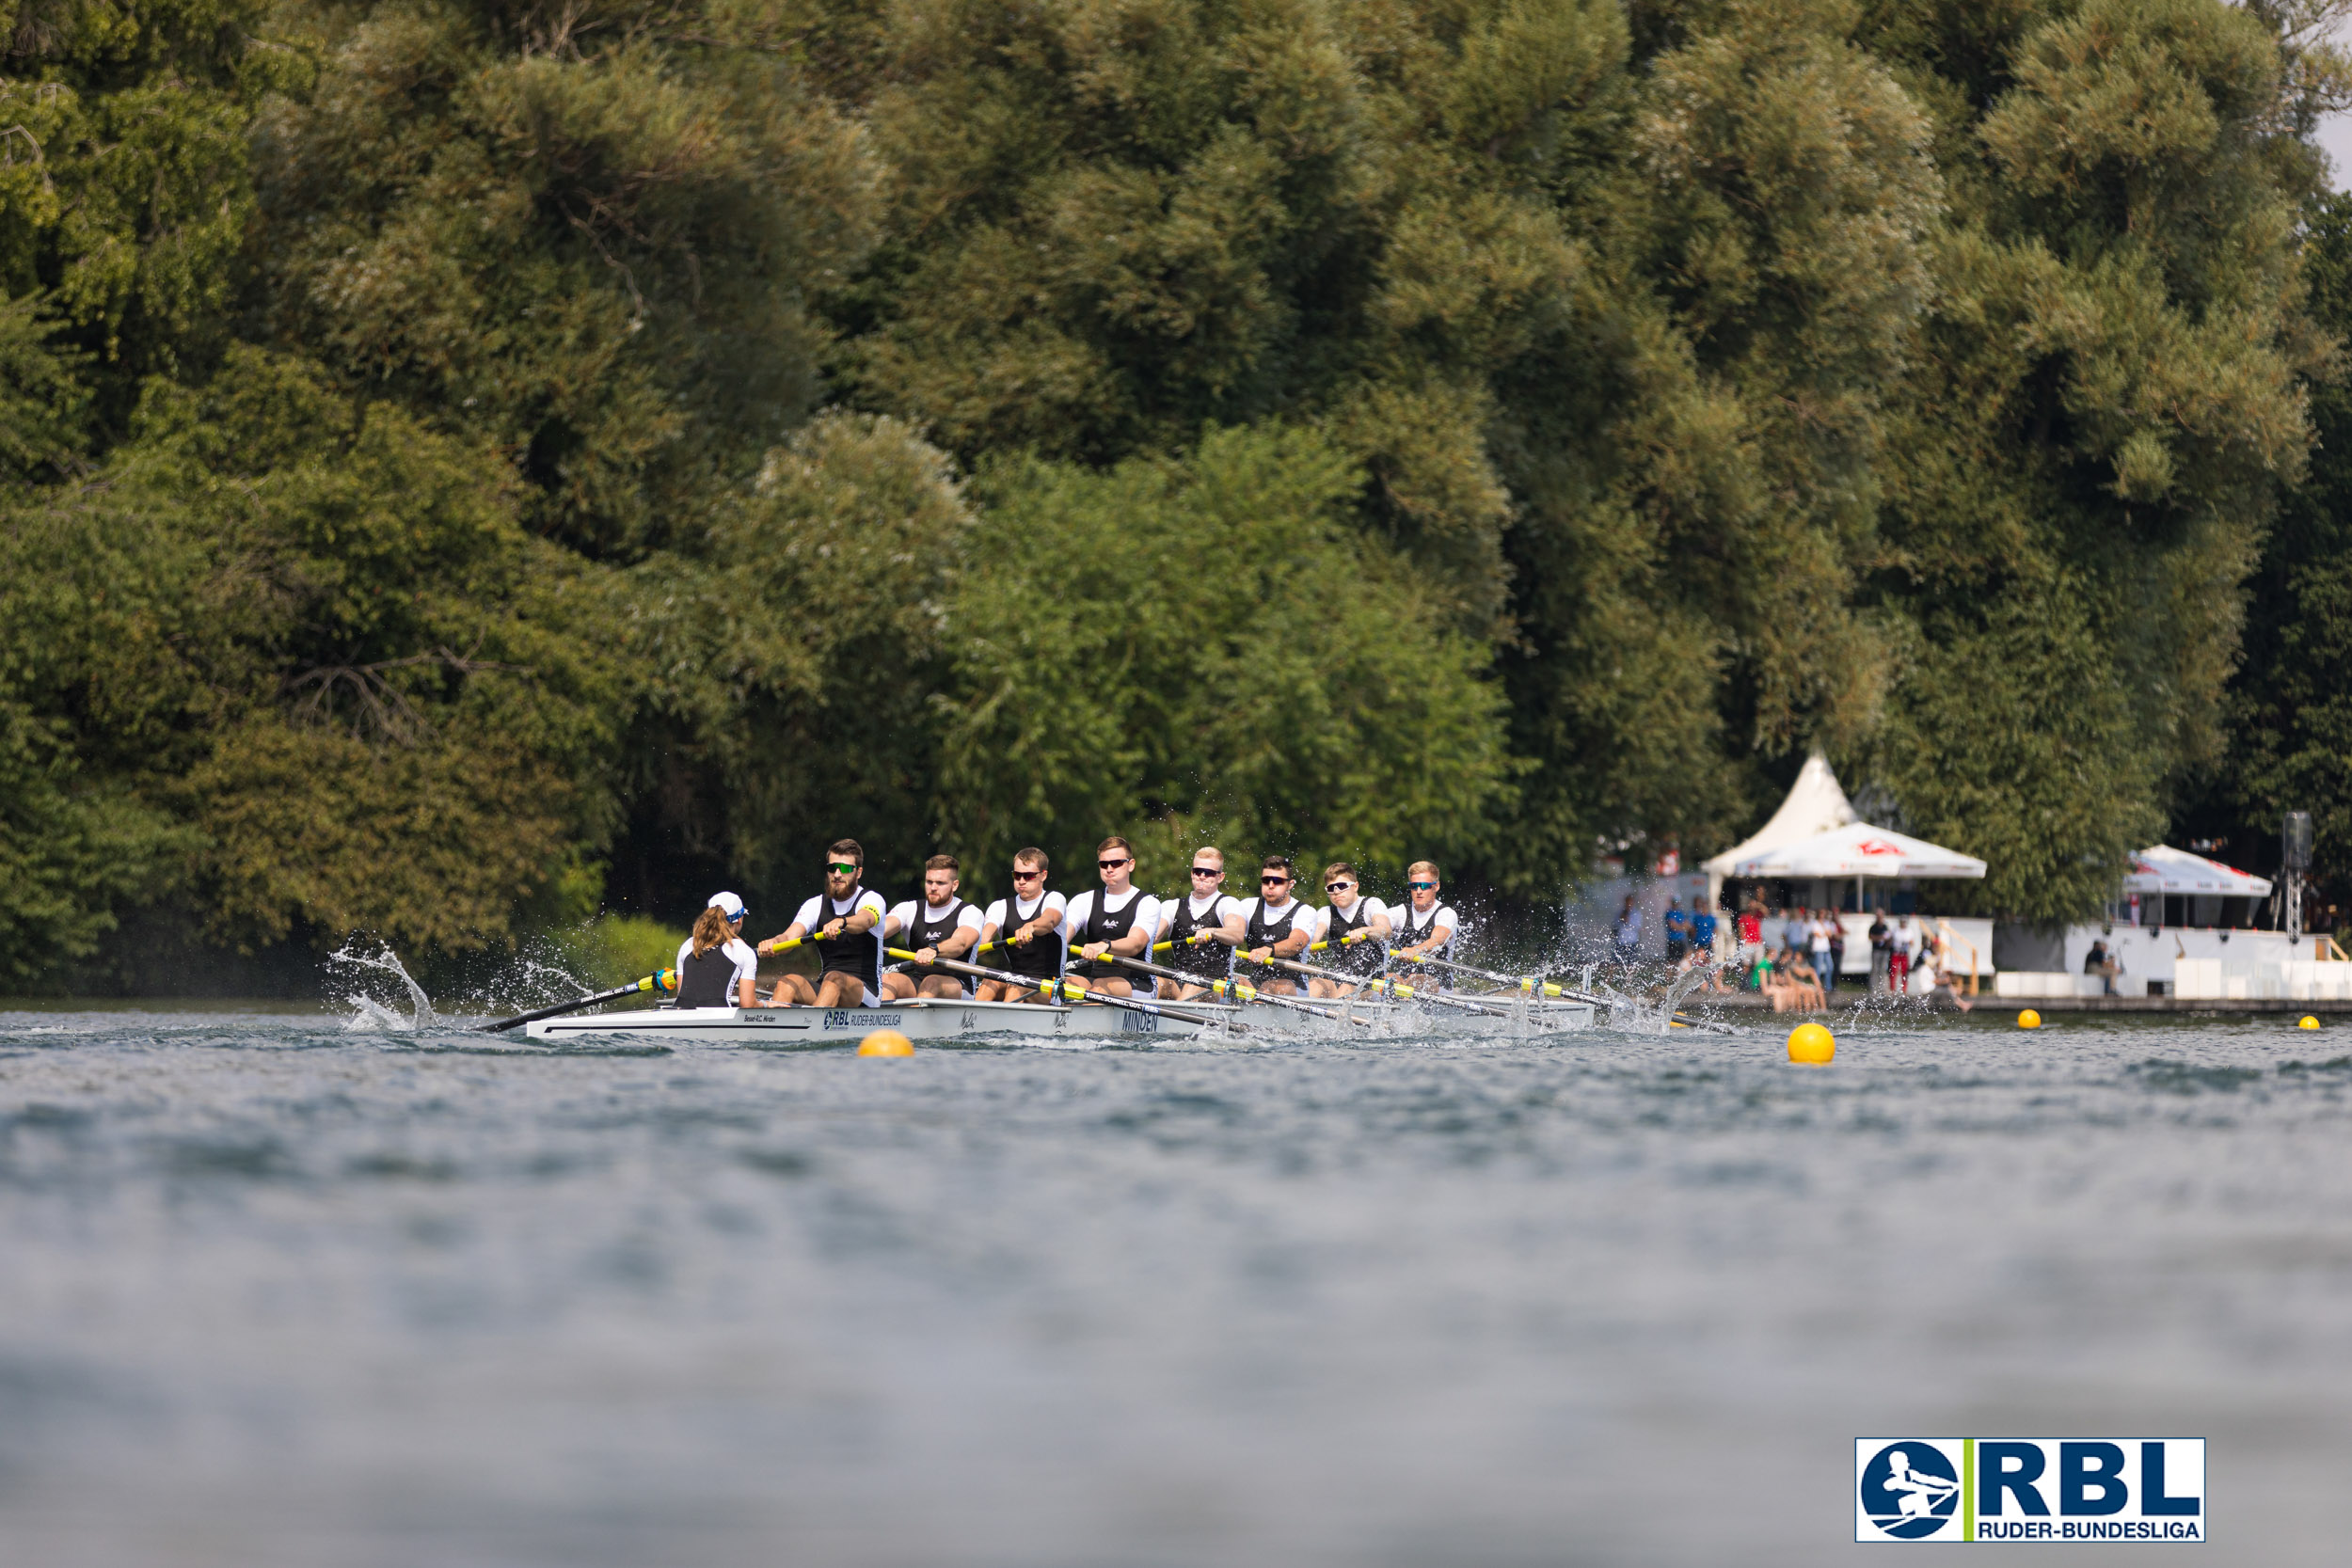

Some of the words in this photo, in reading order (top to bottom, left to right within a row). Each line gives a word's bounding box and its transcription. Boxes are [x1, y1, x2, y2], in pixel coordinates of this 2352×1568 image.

[1145, 1004, 1159, 1013] RBL
[763, 1014, 776, 1023] Minden
[833, 1011, 850, 1026] RBL
[850, 1015, 901, 1026] RUDER-BUNDESLIGA
[1122, 1011, 1158, 1032] MINDEN
